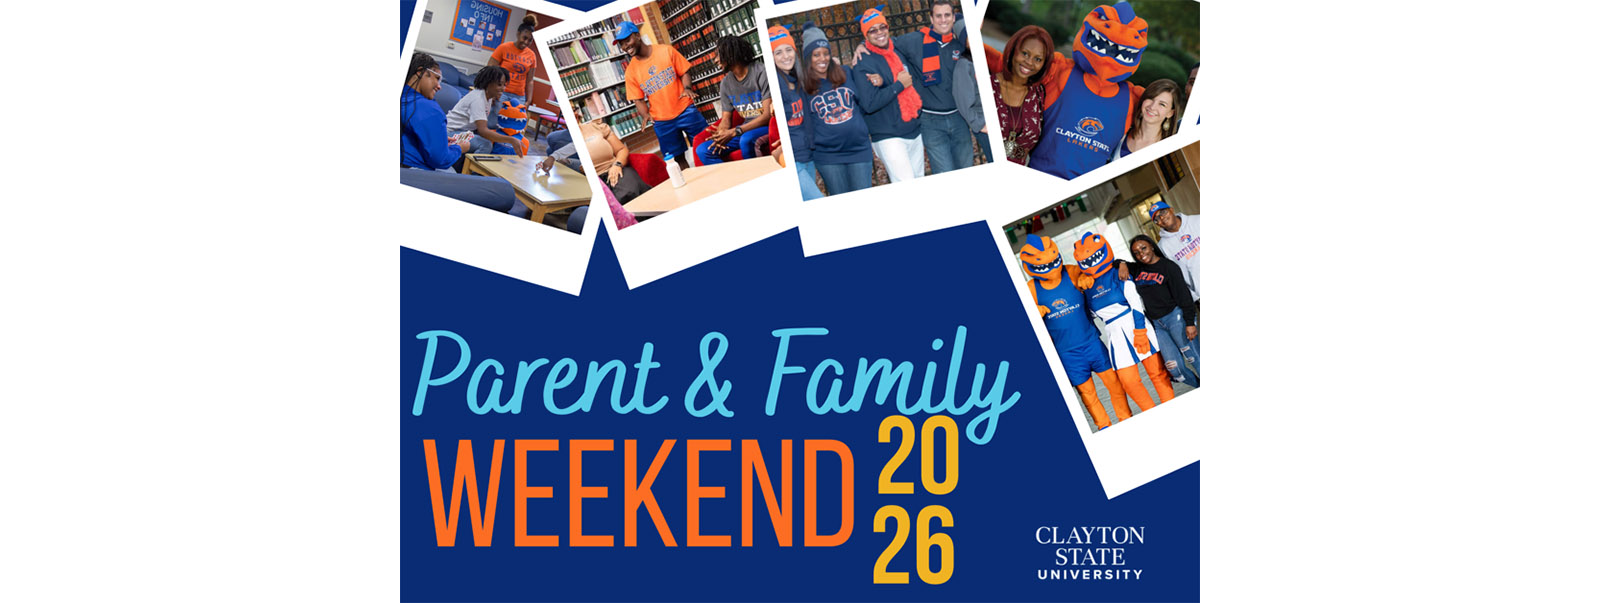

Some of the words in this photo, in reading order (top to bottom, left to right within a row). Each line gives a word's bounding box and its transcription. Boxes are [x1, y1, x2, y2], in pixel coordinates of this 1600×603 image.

[811, 87, 854, 119] CSU
[1056, 128, 1091, 144] CLAYTON
[1067, 138, 1098, 152] LAKERS
[412, 330, 668, 416] Parent
[684, 332, 734, 418] &
[765, 326, 1021, 445] Family
[878, 415, 959, 494] 20
[423, 440, 855, 547] WEEKEND
[873, 505, 954, 585] 26
[1036, 526, 1145, 544] CLAYTON
[1056, 548, 1125, 565] STATE
[1038, 570, 1142, 580] UNIVERSITY
